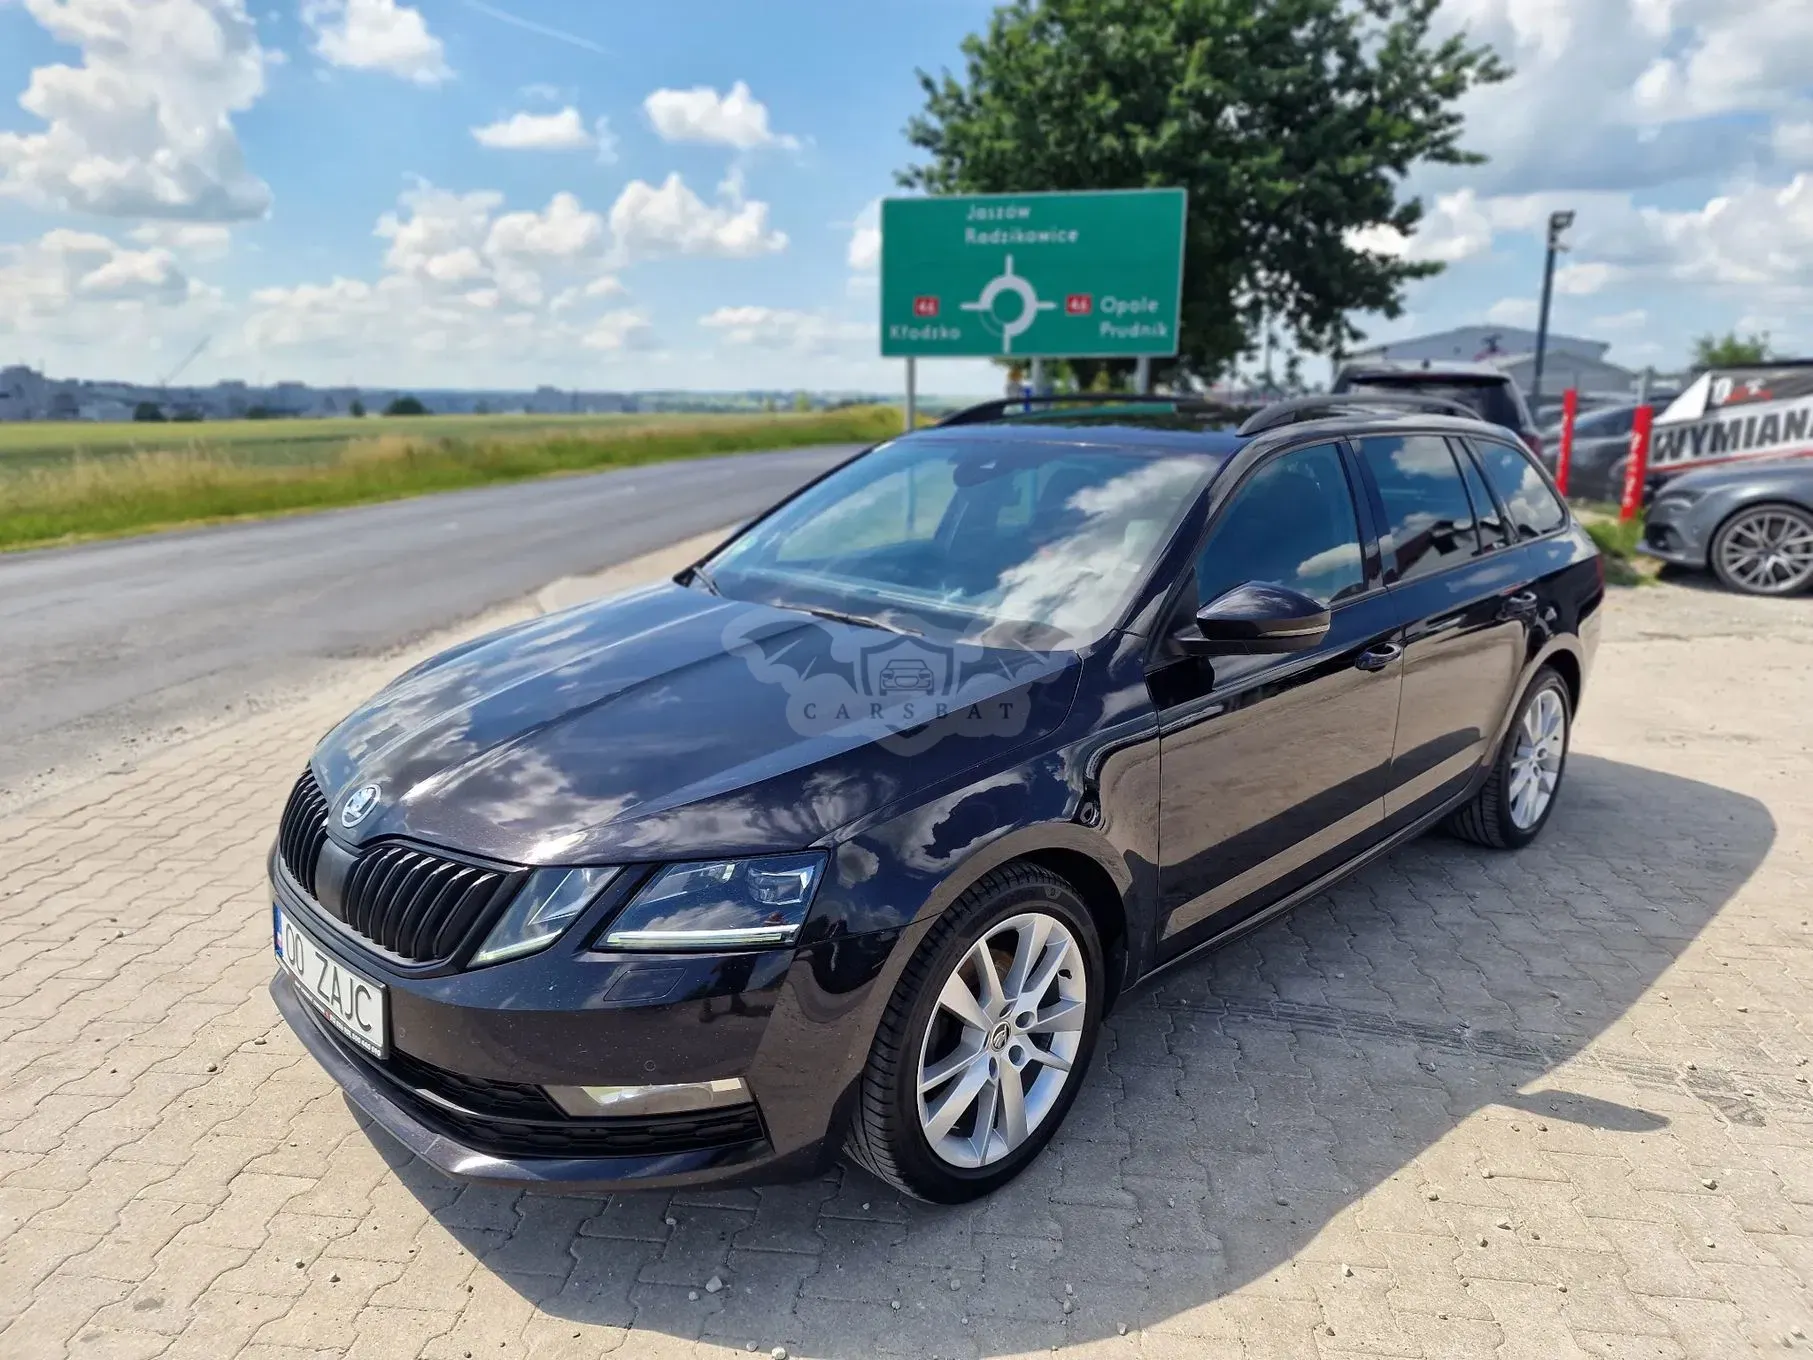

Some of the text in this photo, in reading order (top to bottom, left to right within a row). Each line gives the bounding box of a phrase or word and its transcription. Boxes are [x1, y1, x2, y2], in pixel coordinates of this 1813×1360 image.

[965, 226, 1079, 244] Radzikowice
[1100, 295, 1158, 318] Opole
[889, 324, 961, 340] Kłodzko
[1100, 321, 1167, 338] Prudnik
[1652, 407, 1813, 463] WYMIAN
[315, 951, 372, 1032] ZAJC
